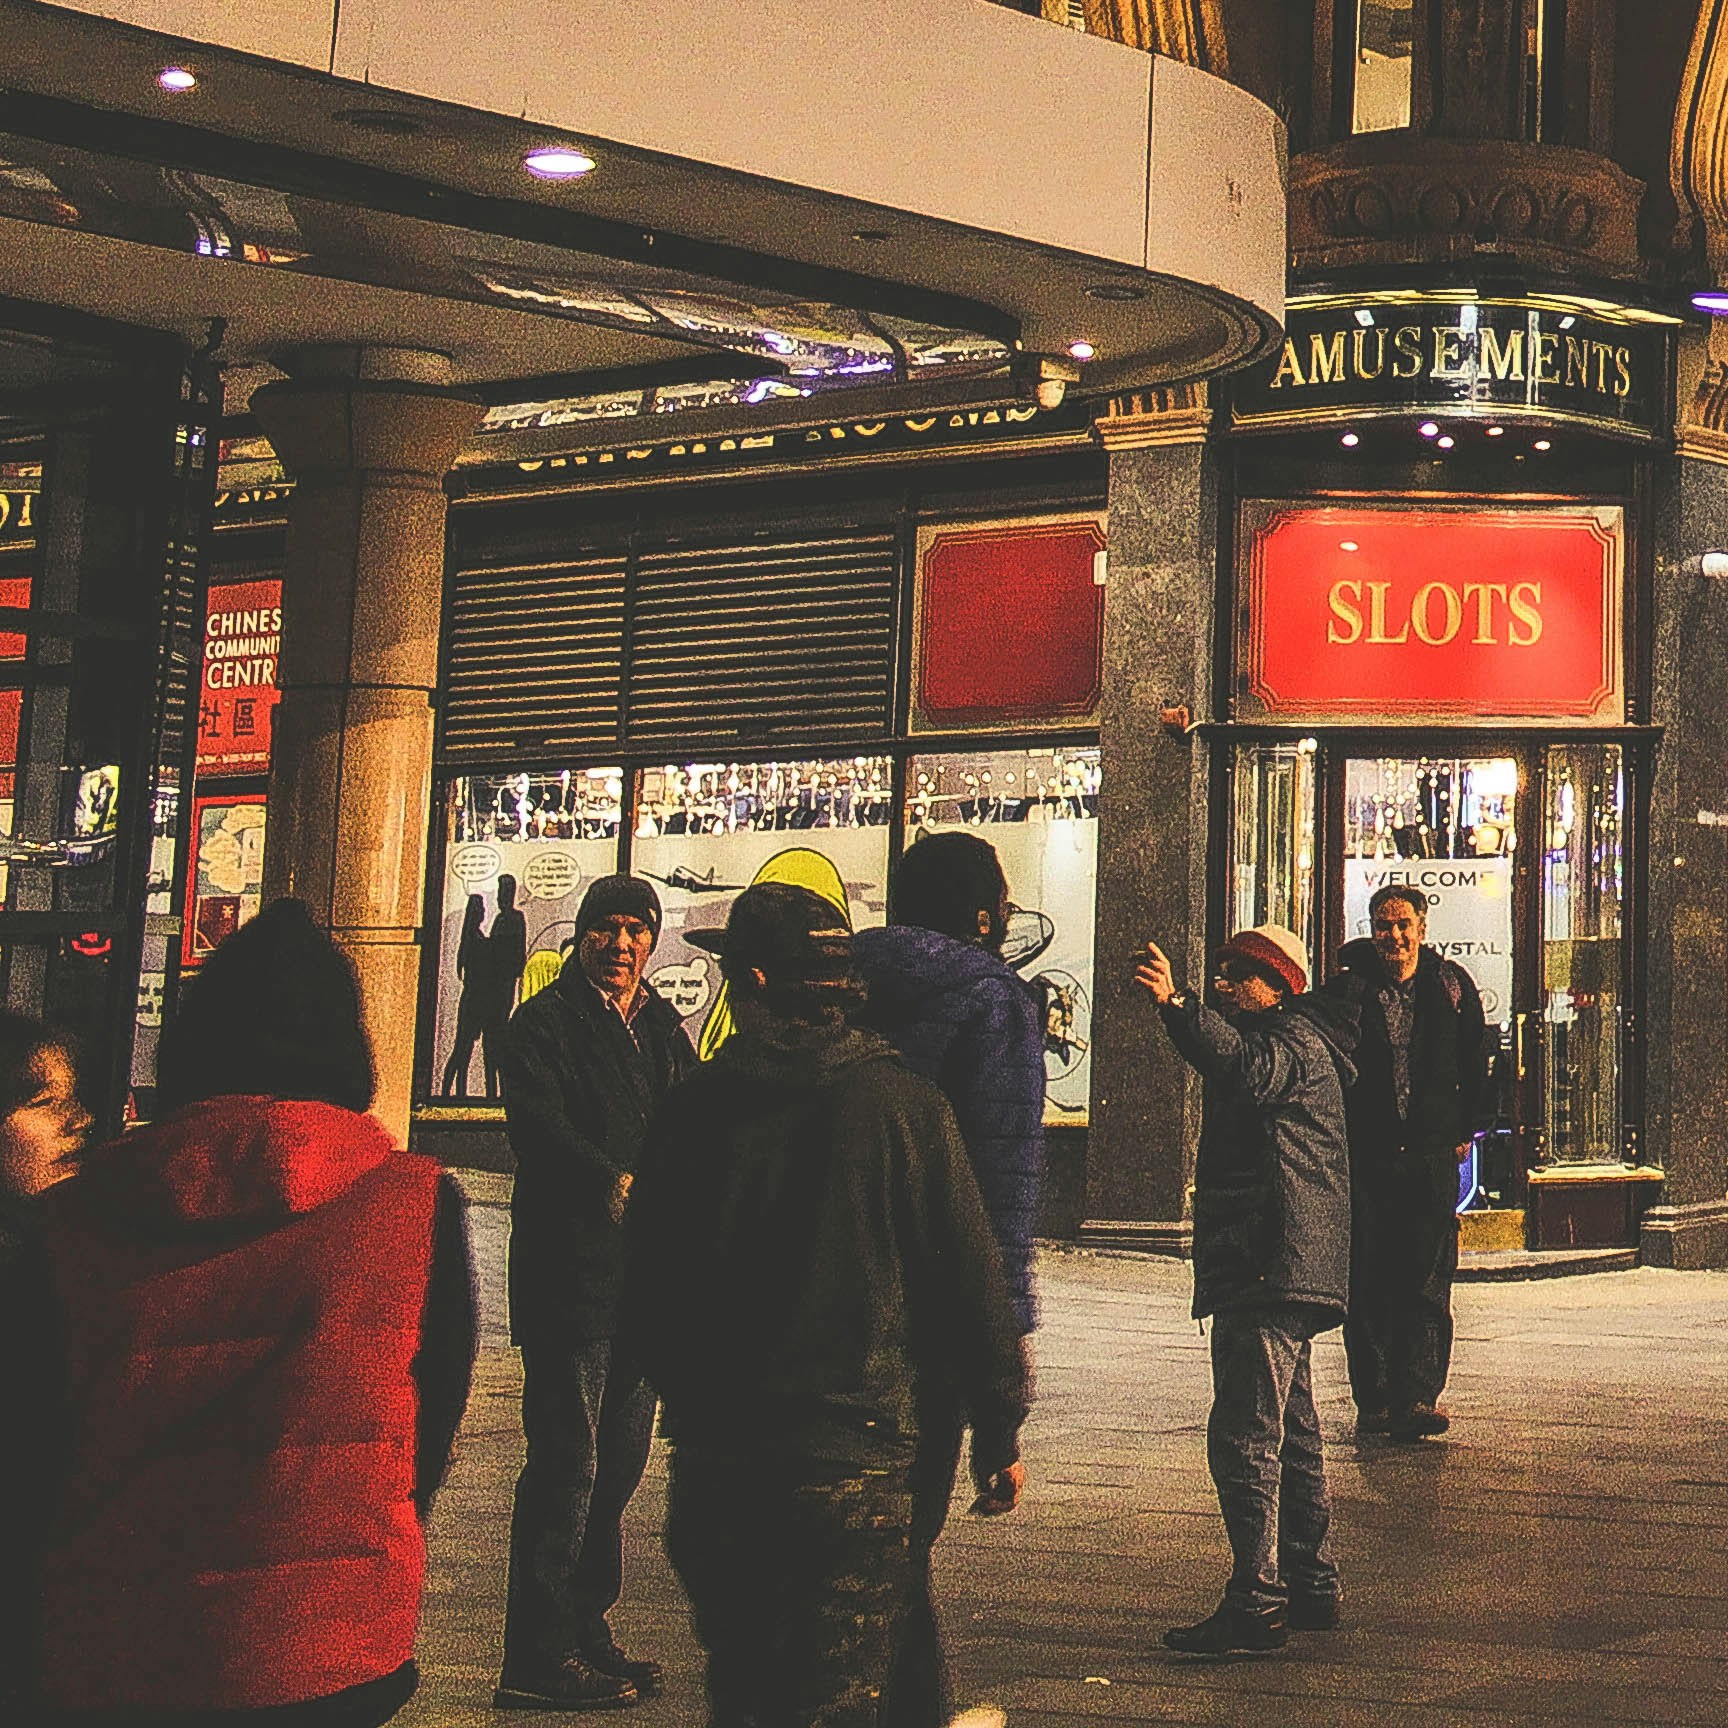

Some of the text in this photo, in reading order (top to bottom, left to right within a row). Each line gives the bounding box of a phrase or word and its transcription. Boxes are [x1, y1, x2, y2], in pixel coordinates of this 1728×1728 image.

[1269, 323, 1631, 398] AMUSEMENTS
[206, 607, 283, 638] CHINES
[1327, 579, 1544, 646] SLOTS
[206, 658, 274, 690] CENTR
[1364, 871, 1496, 888] WELCOM
[1428, 941, 1502, 956] YSTAL
